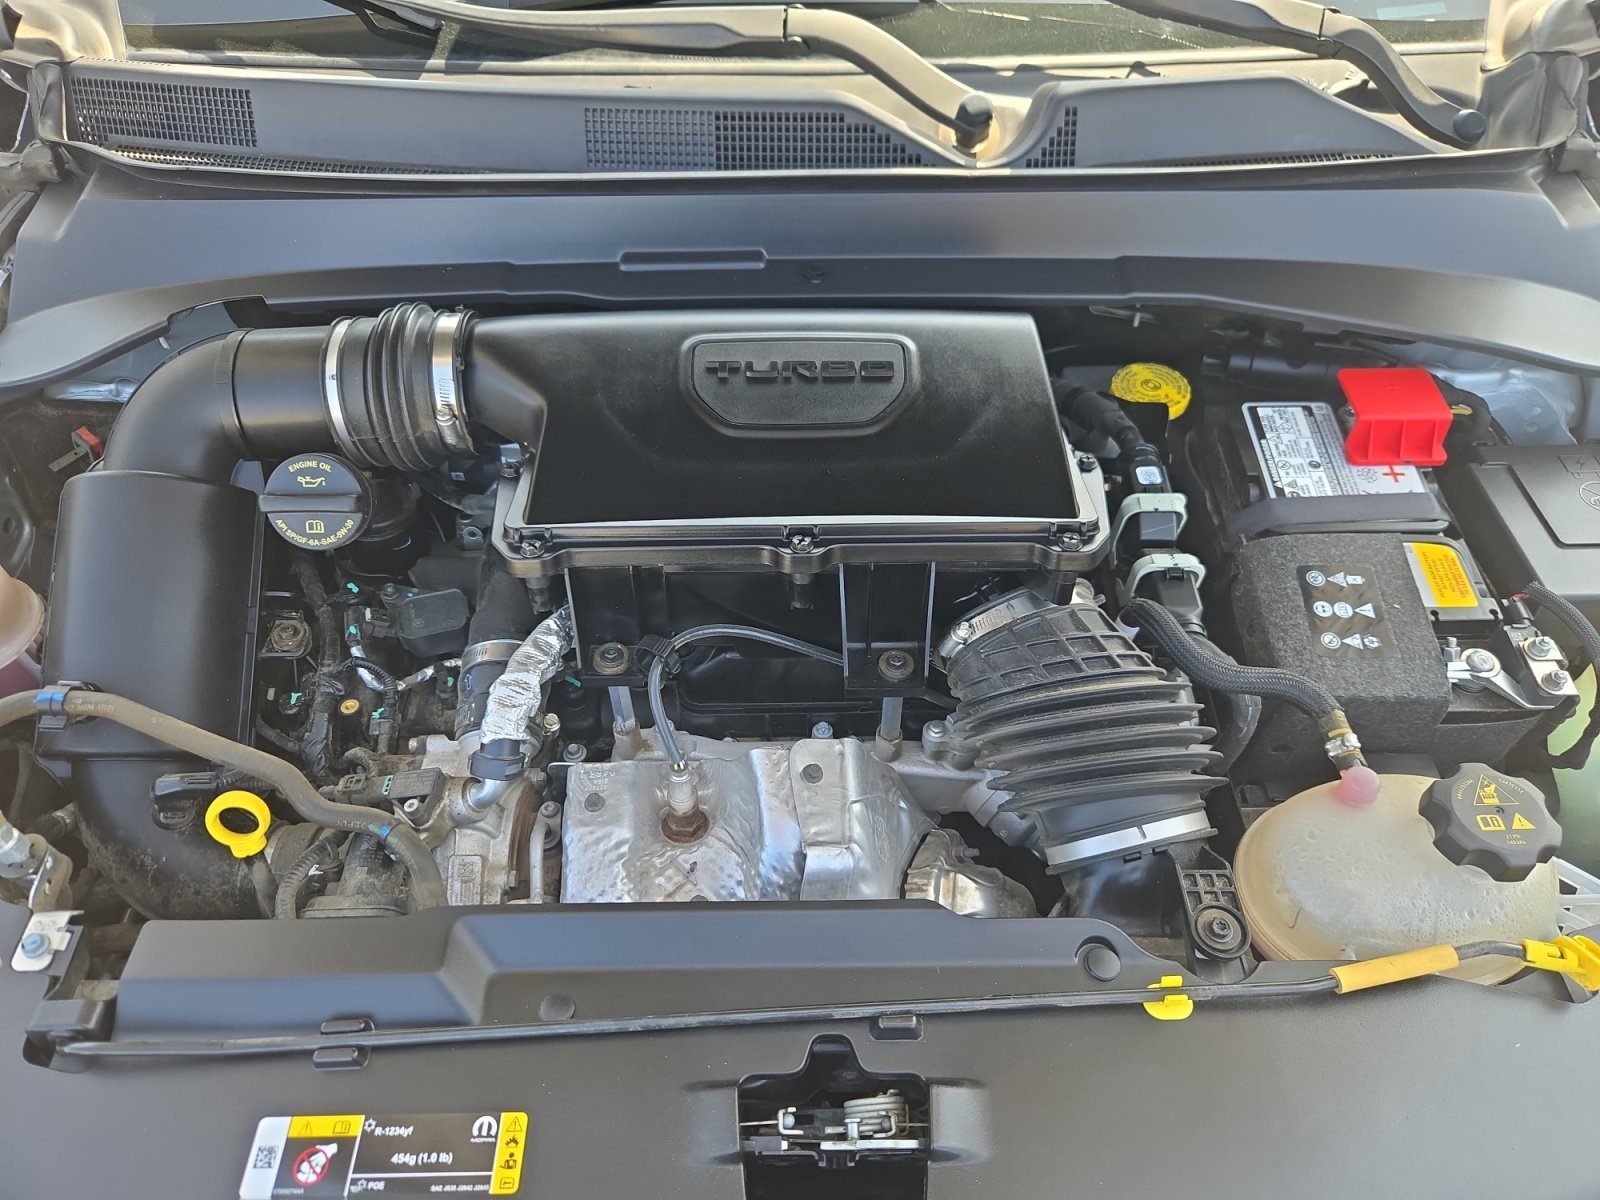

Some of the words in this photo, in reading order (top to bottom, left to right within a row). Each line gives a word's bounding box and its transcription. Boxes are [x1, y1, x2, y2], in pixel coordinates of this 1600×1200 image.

[705, 360, 894, 379] TURBO
[288, 460, 318, 473] ENGINE
[319, 462, 332, 473] OIL
[275, 519, 288, 532] API
[374, 1126, 414, 1138] R-1234yf
[391, 1153, 417, 1166] 454g
[418, 1152, 438, 1166] (1.0
[439, 1152, 453, 1165] lb)
[367, 1181, 385, 1191] POE
